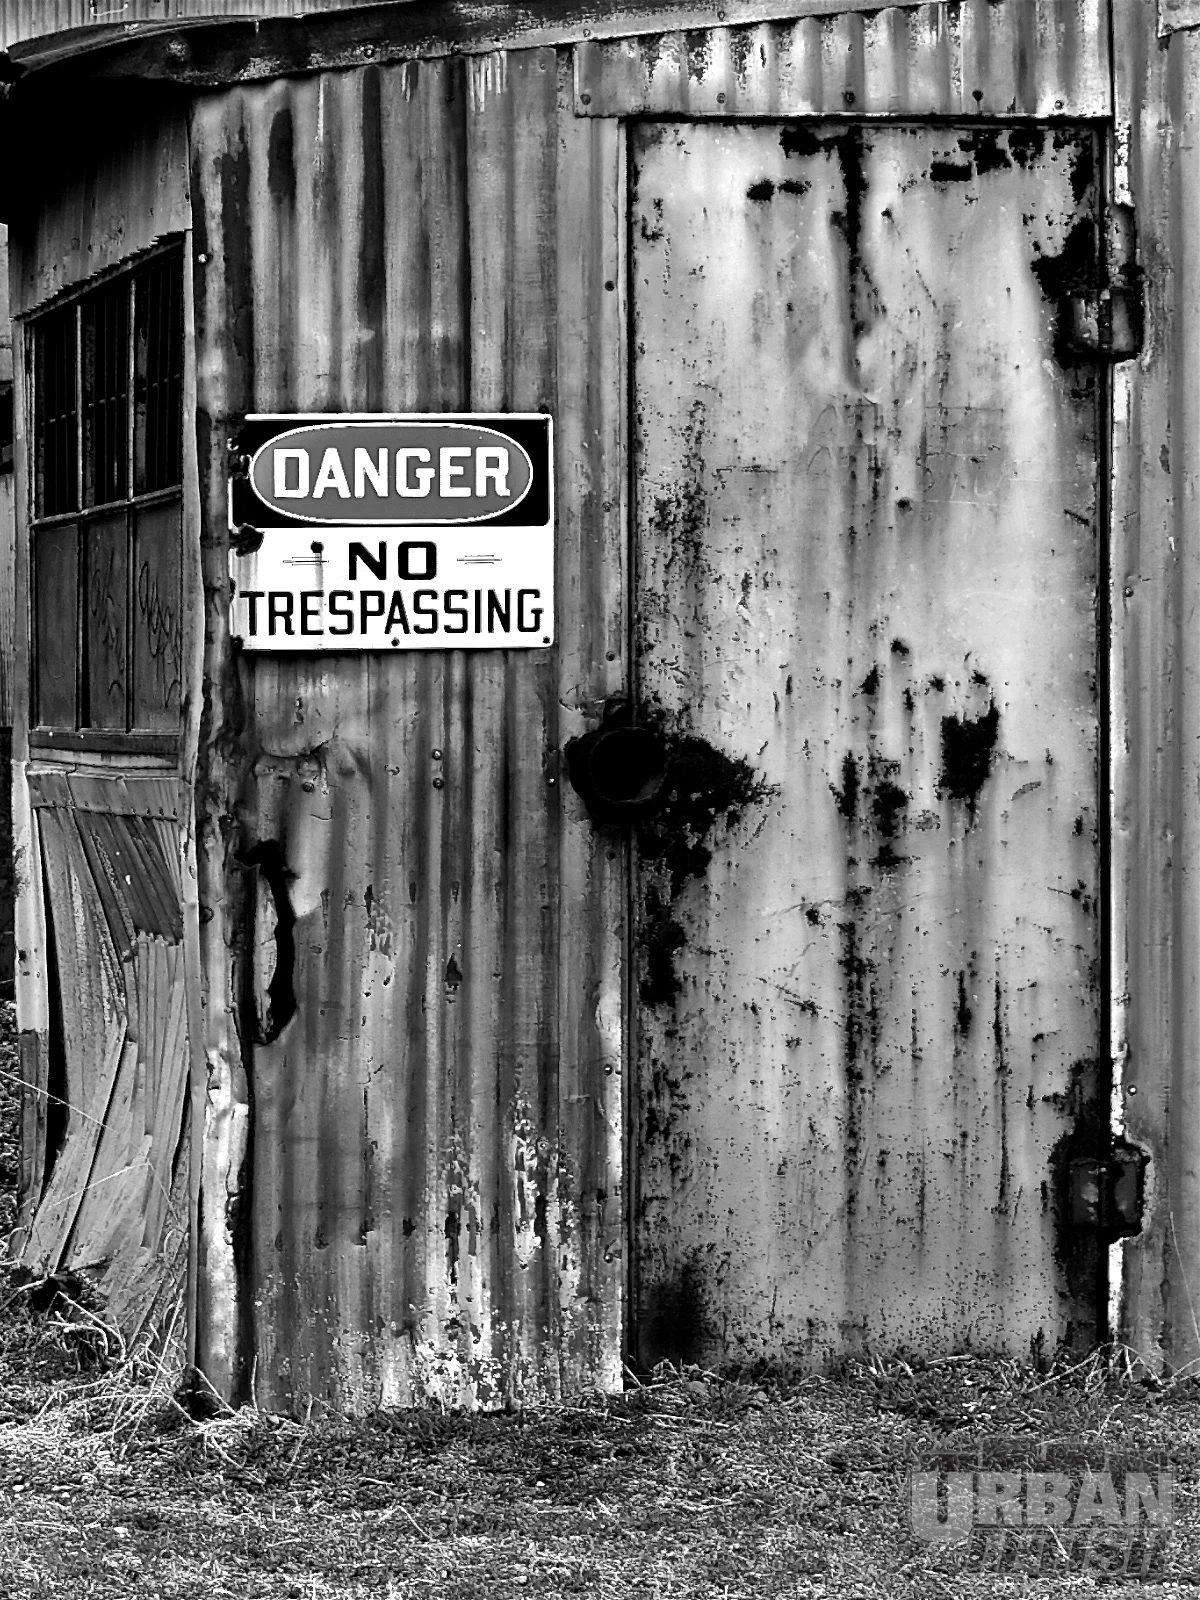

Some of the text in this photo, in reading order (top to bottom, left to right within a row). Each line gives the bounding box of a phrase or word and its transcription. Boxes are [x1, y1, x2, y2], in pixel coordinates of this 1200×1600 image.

[273, 446, 511, 499] DANGER
[348, 541, 438, 581] NO
[239, 588, 544, 636] TRESPASSING
